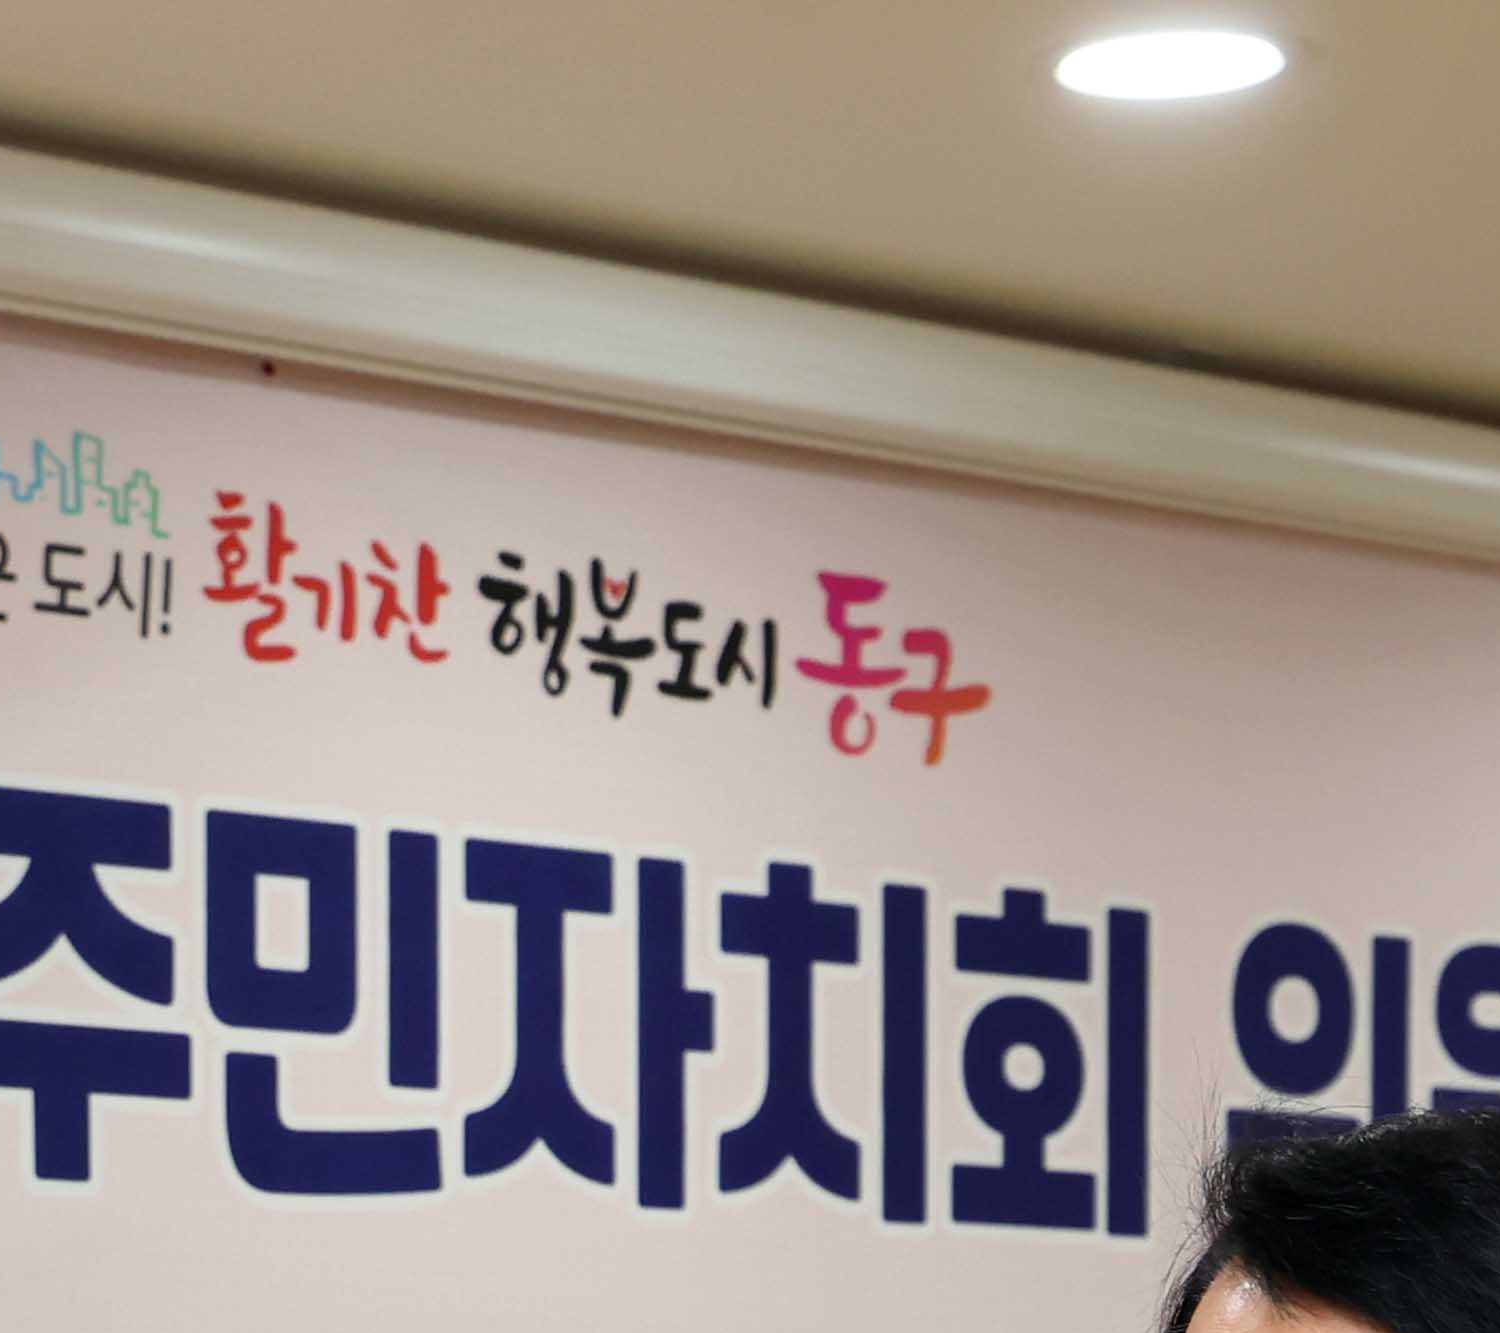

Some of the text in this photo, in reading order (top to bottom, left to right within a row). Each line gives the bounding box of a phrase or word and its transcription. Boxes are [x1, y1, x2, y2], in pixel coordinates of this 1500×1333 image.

[32, 544, 173, 638] 도시!
[203, 490, 450, 664] 활기찬
[477, 551, 777, 718] 행복도시
[796, 571, 991, 765] 동구
